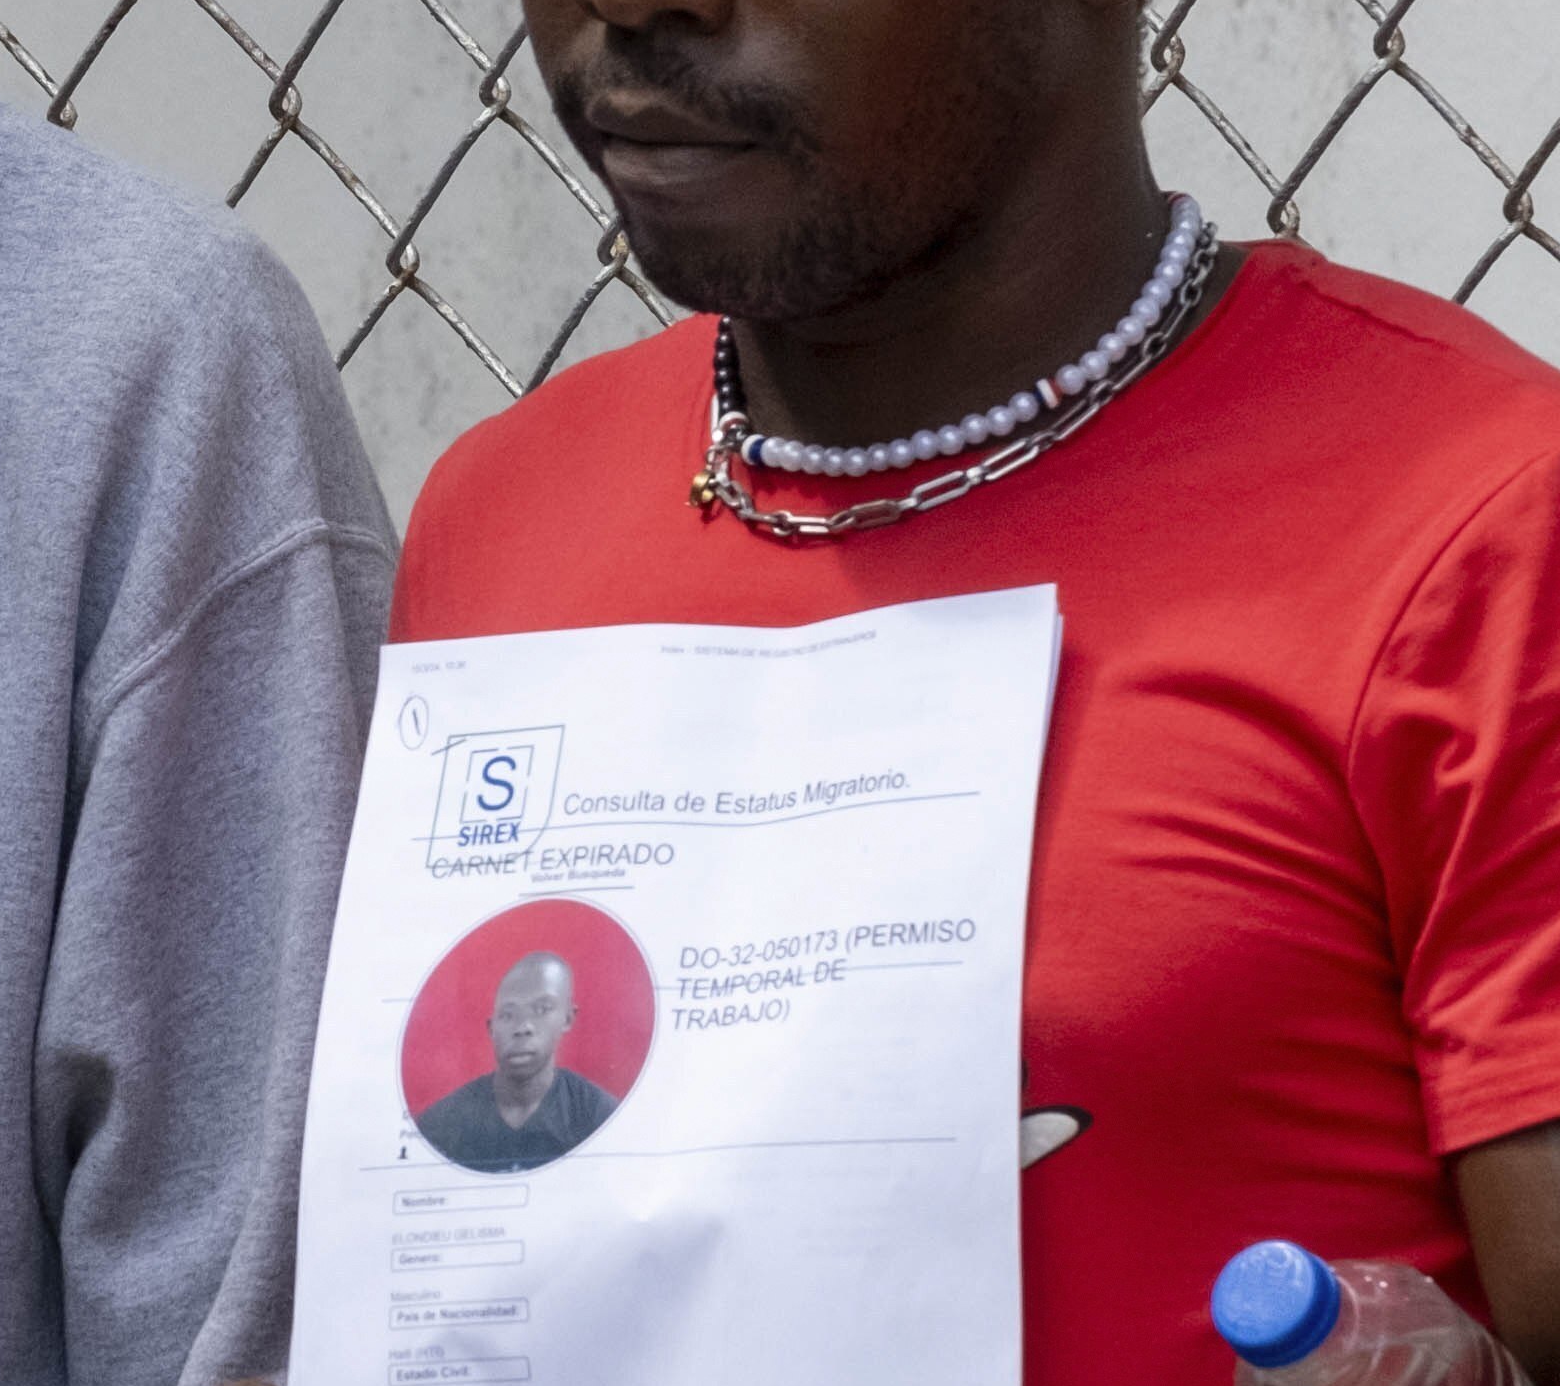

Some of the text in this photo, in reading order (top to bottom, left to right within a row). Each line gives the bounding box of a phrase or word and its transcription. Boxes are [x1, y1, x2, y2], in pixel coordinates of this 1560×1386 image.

[476, 755, 517, 811] S
[563, 768, 912, 815] Consulta de Estatus Migratorio.
[457, 821, 521, 848] SIREX
[431, 843, 675, 879] CARNET EXPIRADO
[680, 918, 977, 971] DO-32-050173 (PERMISO
[677, 959, 848, 1001] TEMPORAL DE
[671, 998, 791, 1032] TRABAJO)
